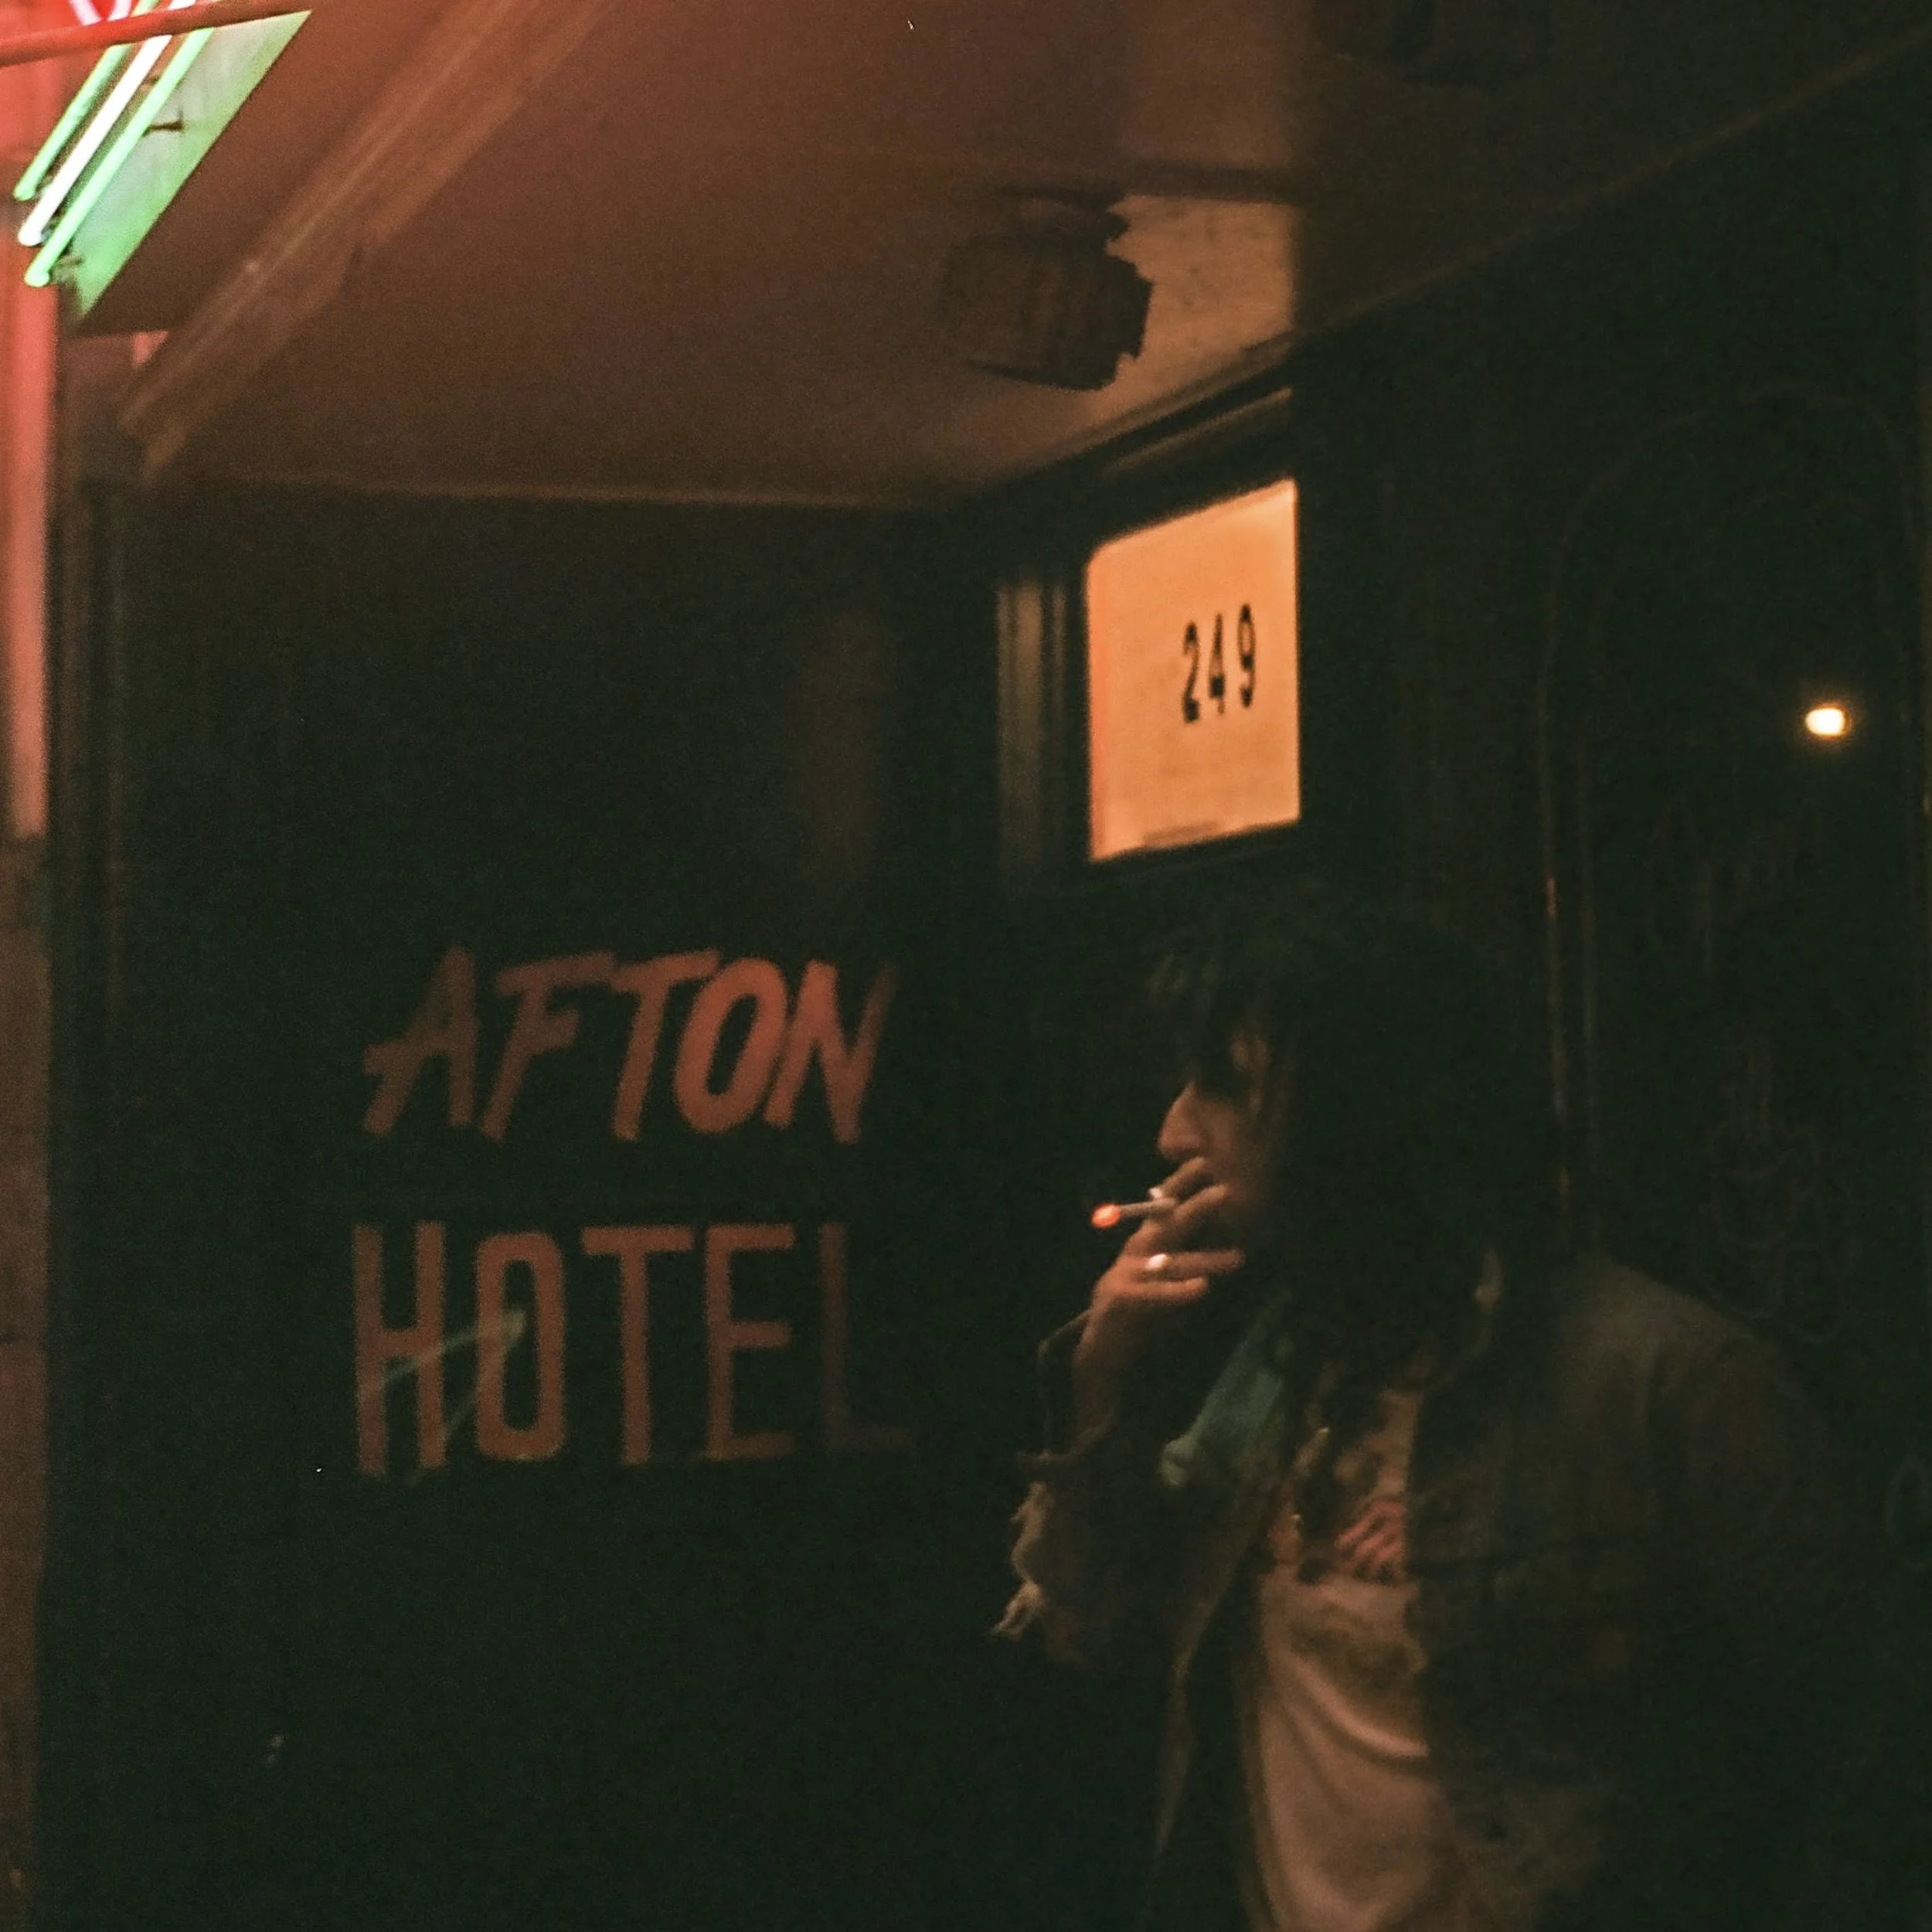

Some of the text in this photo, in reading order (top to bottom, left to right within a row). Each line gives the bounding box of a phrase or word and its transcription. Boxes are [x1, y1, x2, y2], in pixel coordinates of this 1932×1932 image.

[1182, 603, 1256, 723] 249
[362, 947, 898, 1145] AFTON
[352, 1220, 913, 1477] HOTEL
